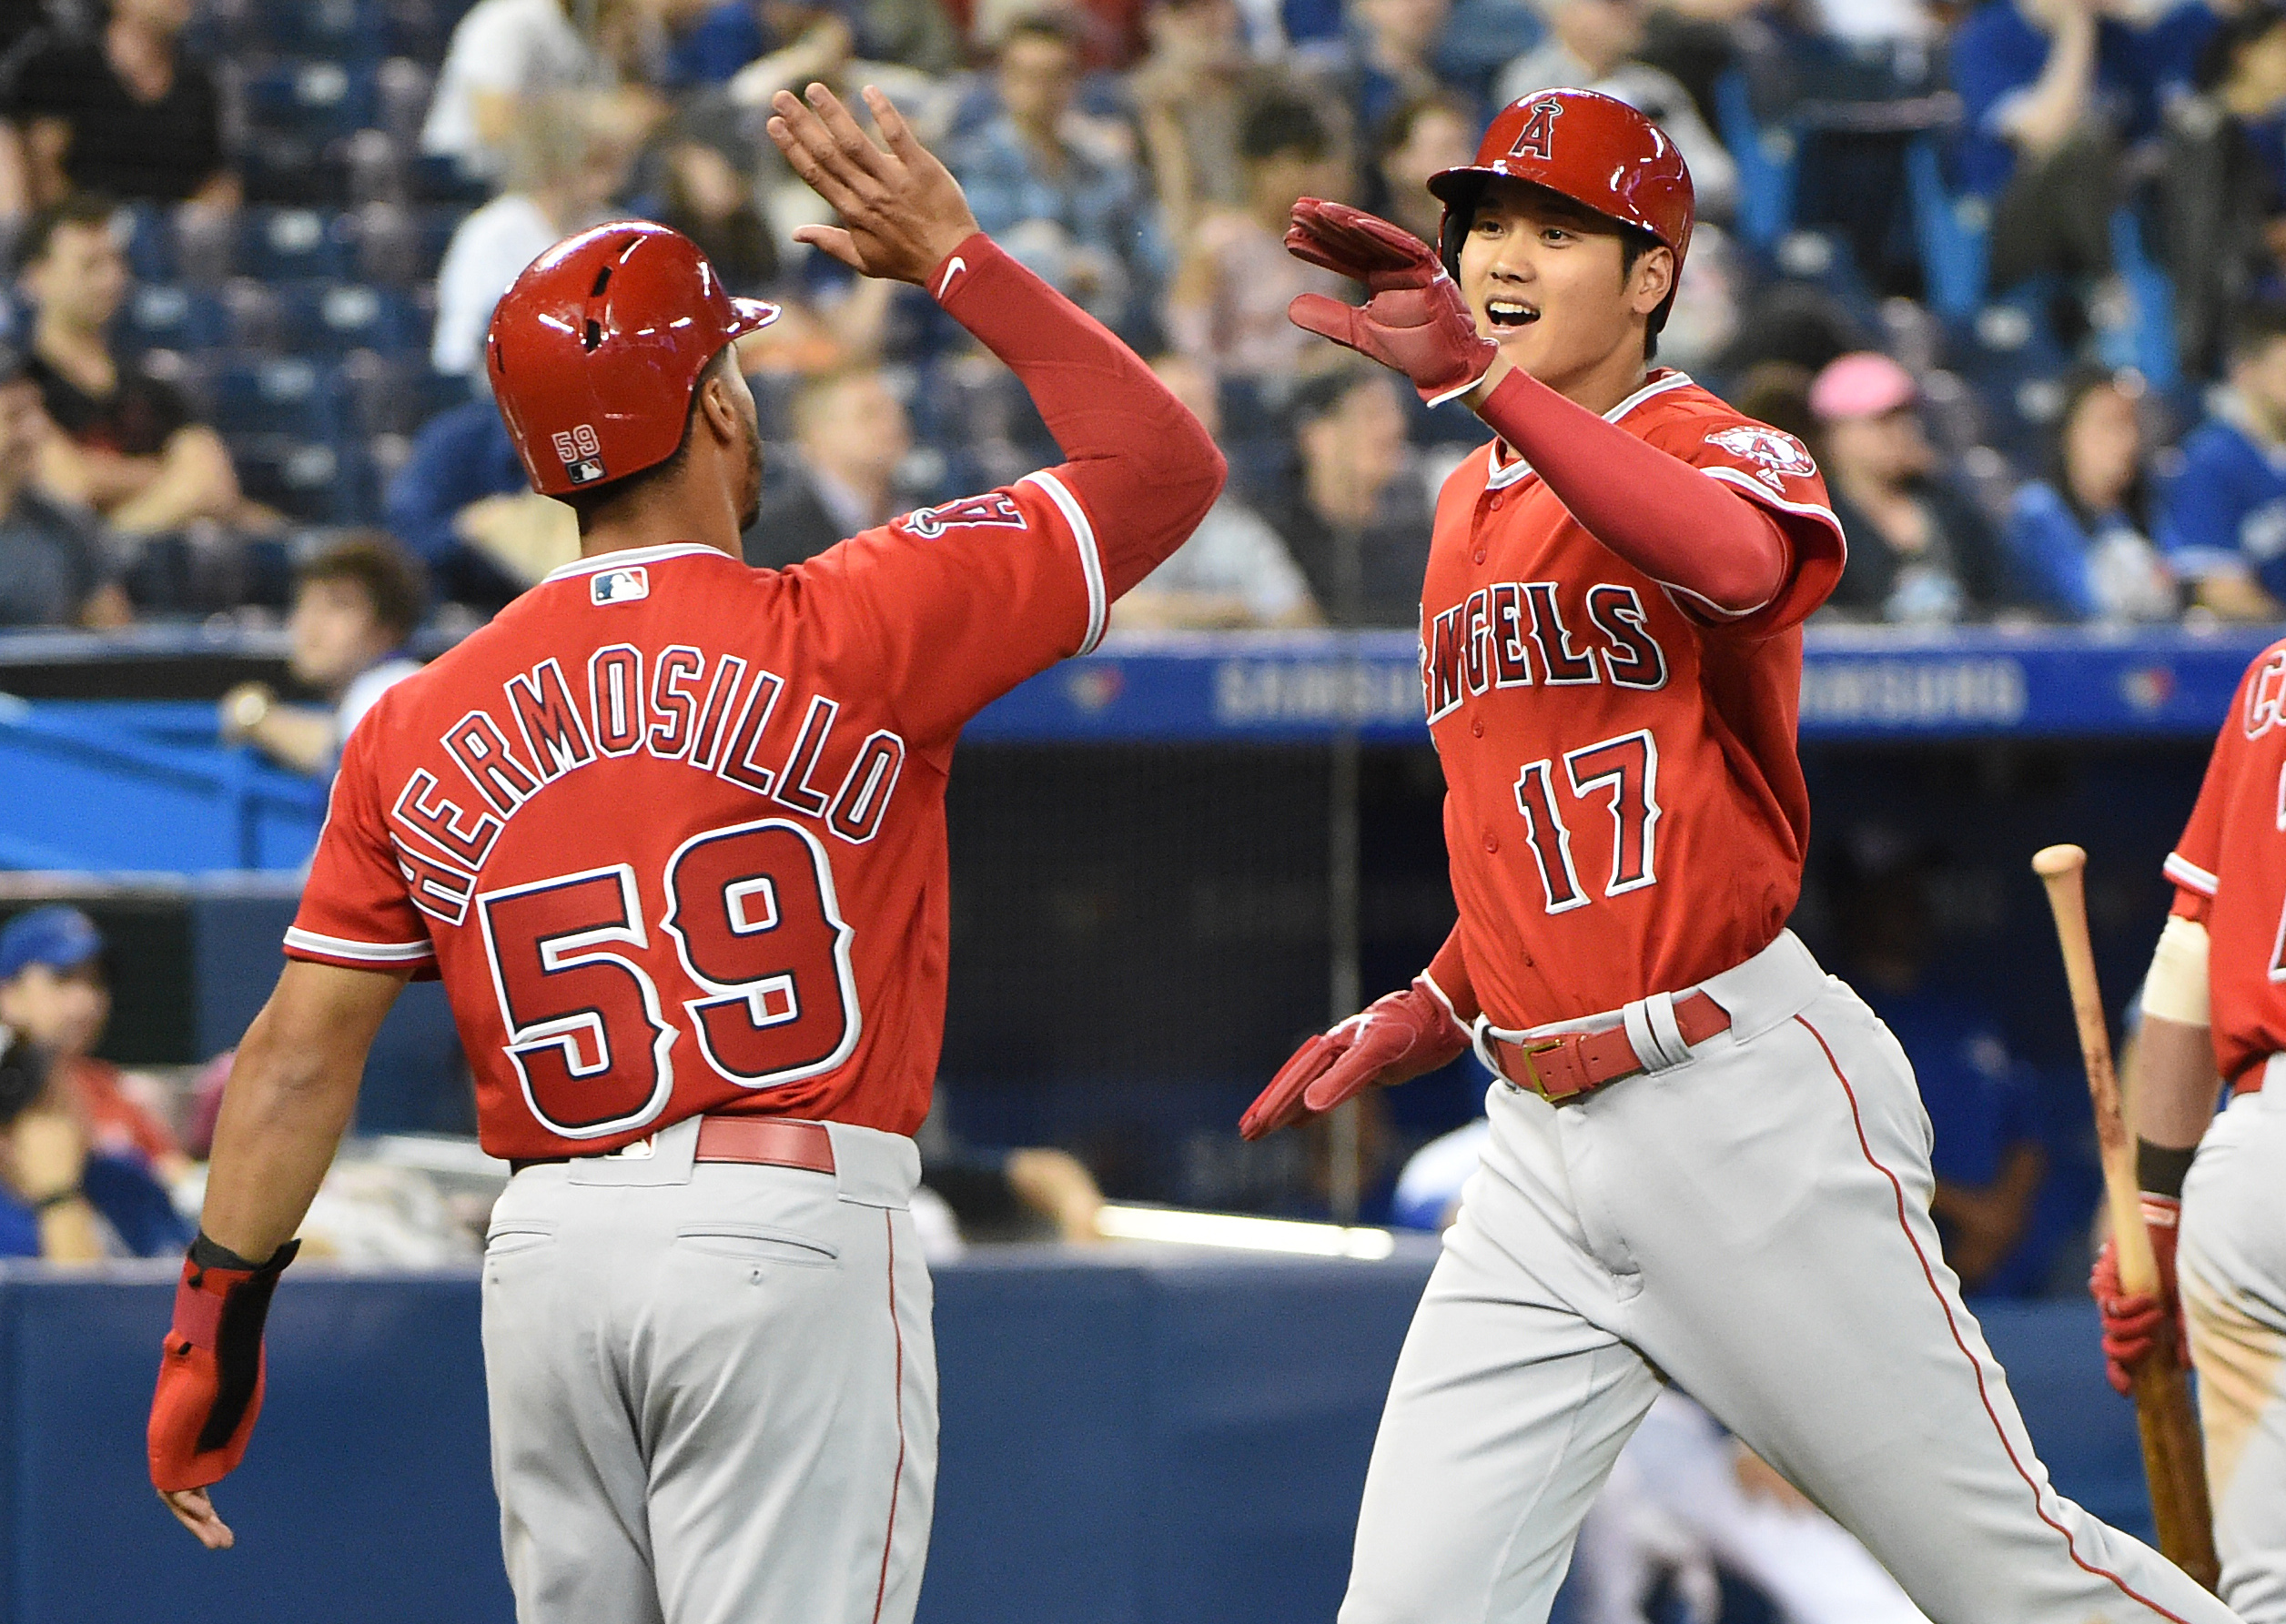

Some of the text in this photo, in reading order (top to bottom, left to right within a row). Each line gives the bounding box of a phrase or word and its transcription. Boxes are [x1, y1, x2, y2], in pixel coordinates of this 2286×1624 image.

[551, 424, 601, 464] 59
[1418, 581, 1669, 728] NGELS
[389, 642, 906, 926] HERMOSILLO
[1514, 729, 1663, 915] 17
[475, 817, 863, 1139] 59
